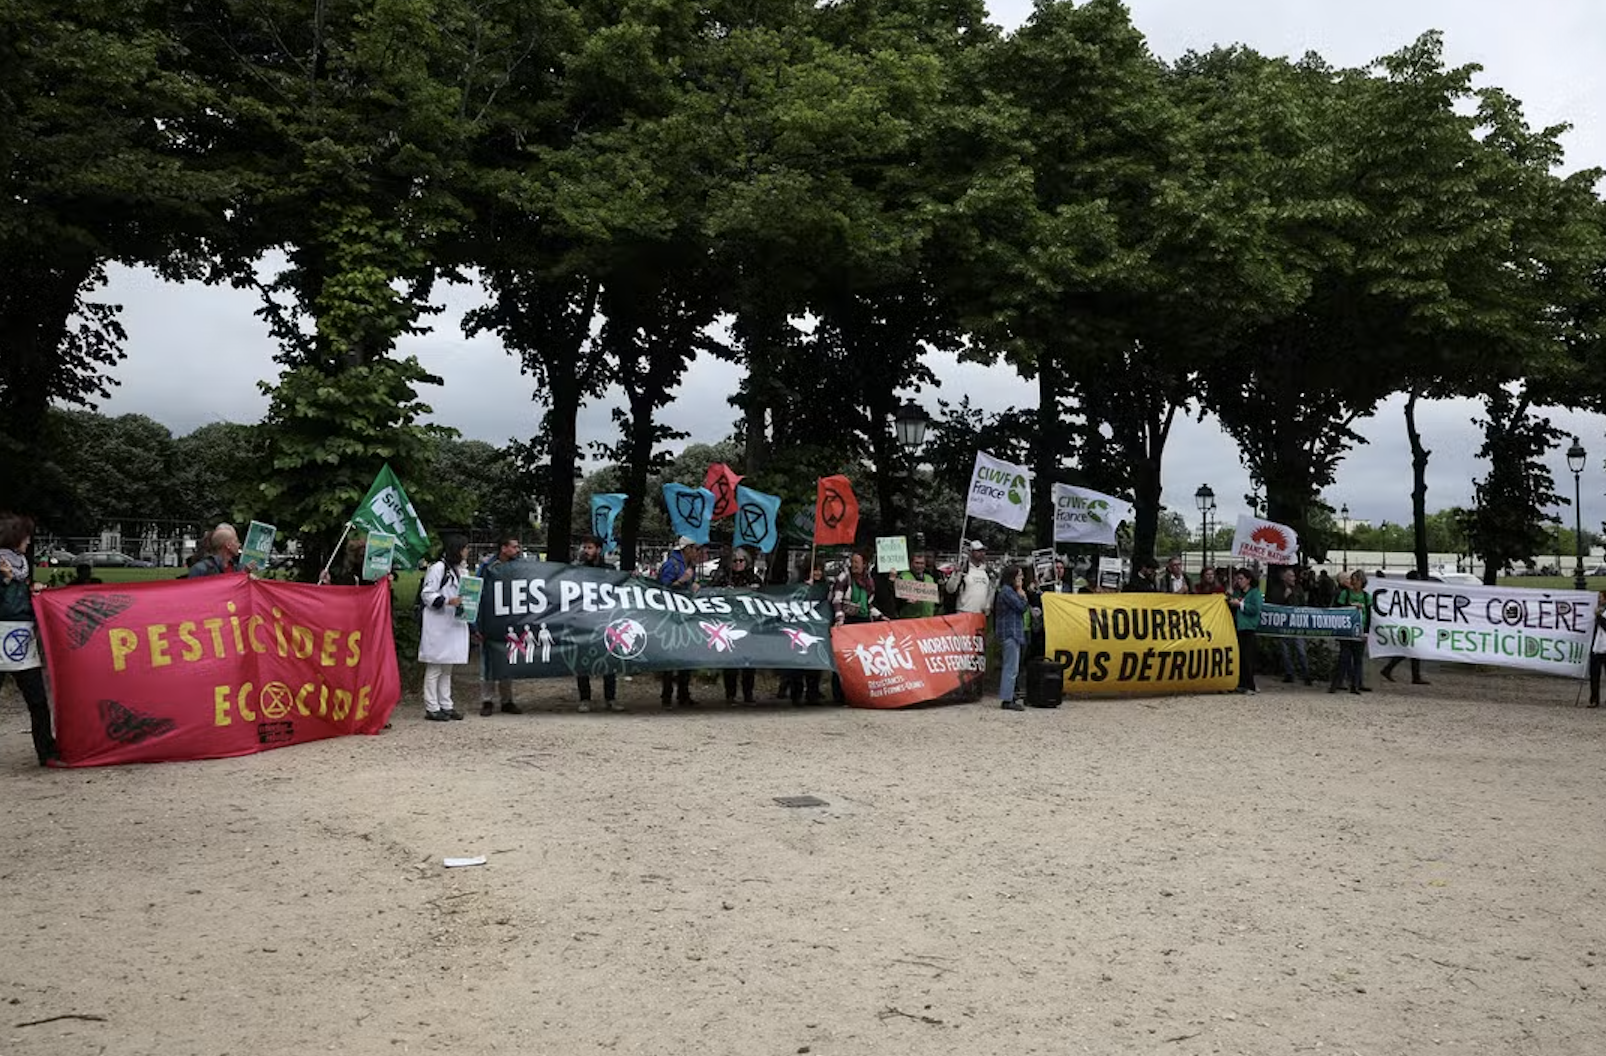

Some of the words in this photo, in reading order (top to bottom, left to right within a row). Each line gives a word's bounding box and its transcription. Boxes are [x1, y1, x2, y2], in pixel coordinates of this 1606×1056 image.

[977, 466, 1011, 486] CIWF
[973, 480, 1005, 499] France
[1058, 496, 1088, 509] CIWF
[1057, 508, 1087, 523] France
[493, 578, 549, 616] LES
[560, 581, 730, 615] PESTICIDES
[1260, 611, 1287, 626] STOP
[1289, 613, 1310, 628] AUX
[1312, 615, 1352, 629] TOXIQUES
[1372, 588, 1471, 624] CANCER
[1486, 594, 1588, 633] COLÈRE
[1089, 607, 1212, 641] NOURRIR,
[916, 635, 973, 654] MORATOIRE
[1374, 625, 1424, 647] STOP
[925, 656, 946, 674] LES
[1054, 650, 1110, 682] PAS
[1117, 647, 1234, 682] DÉTRUIRE
